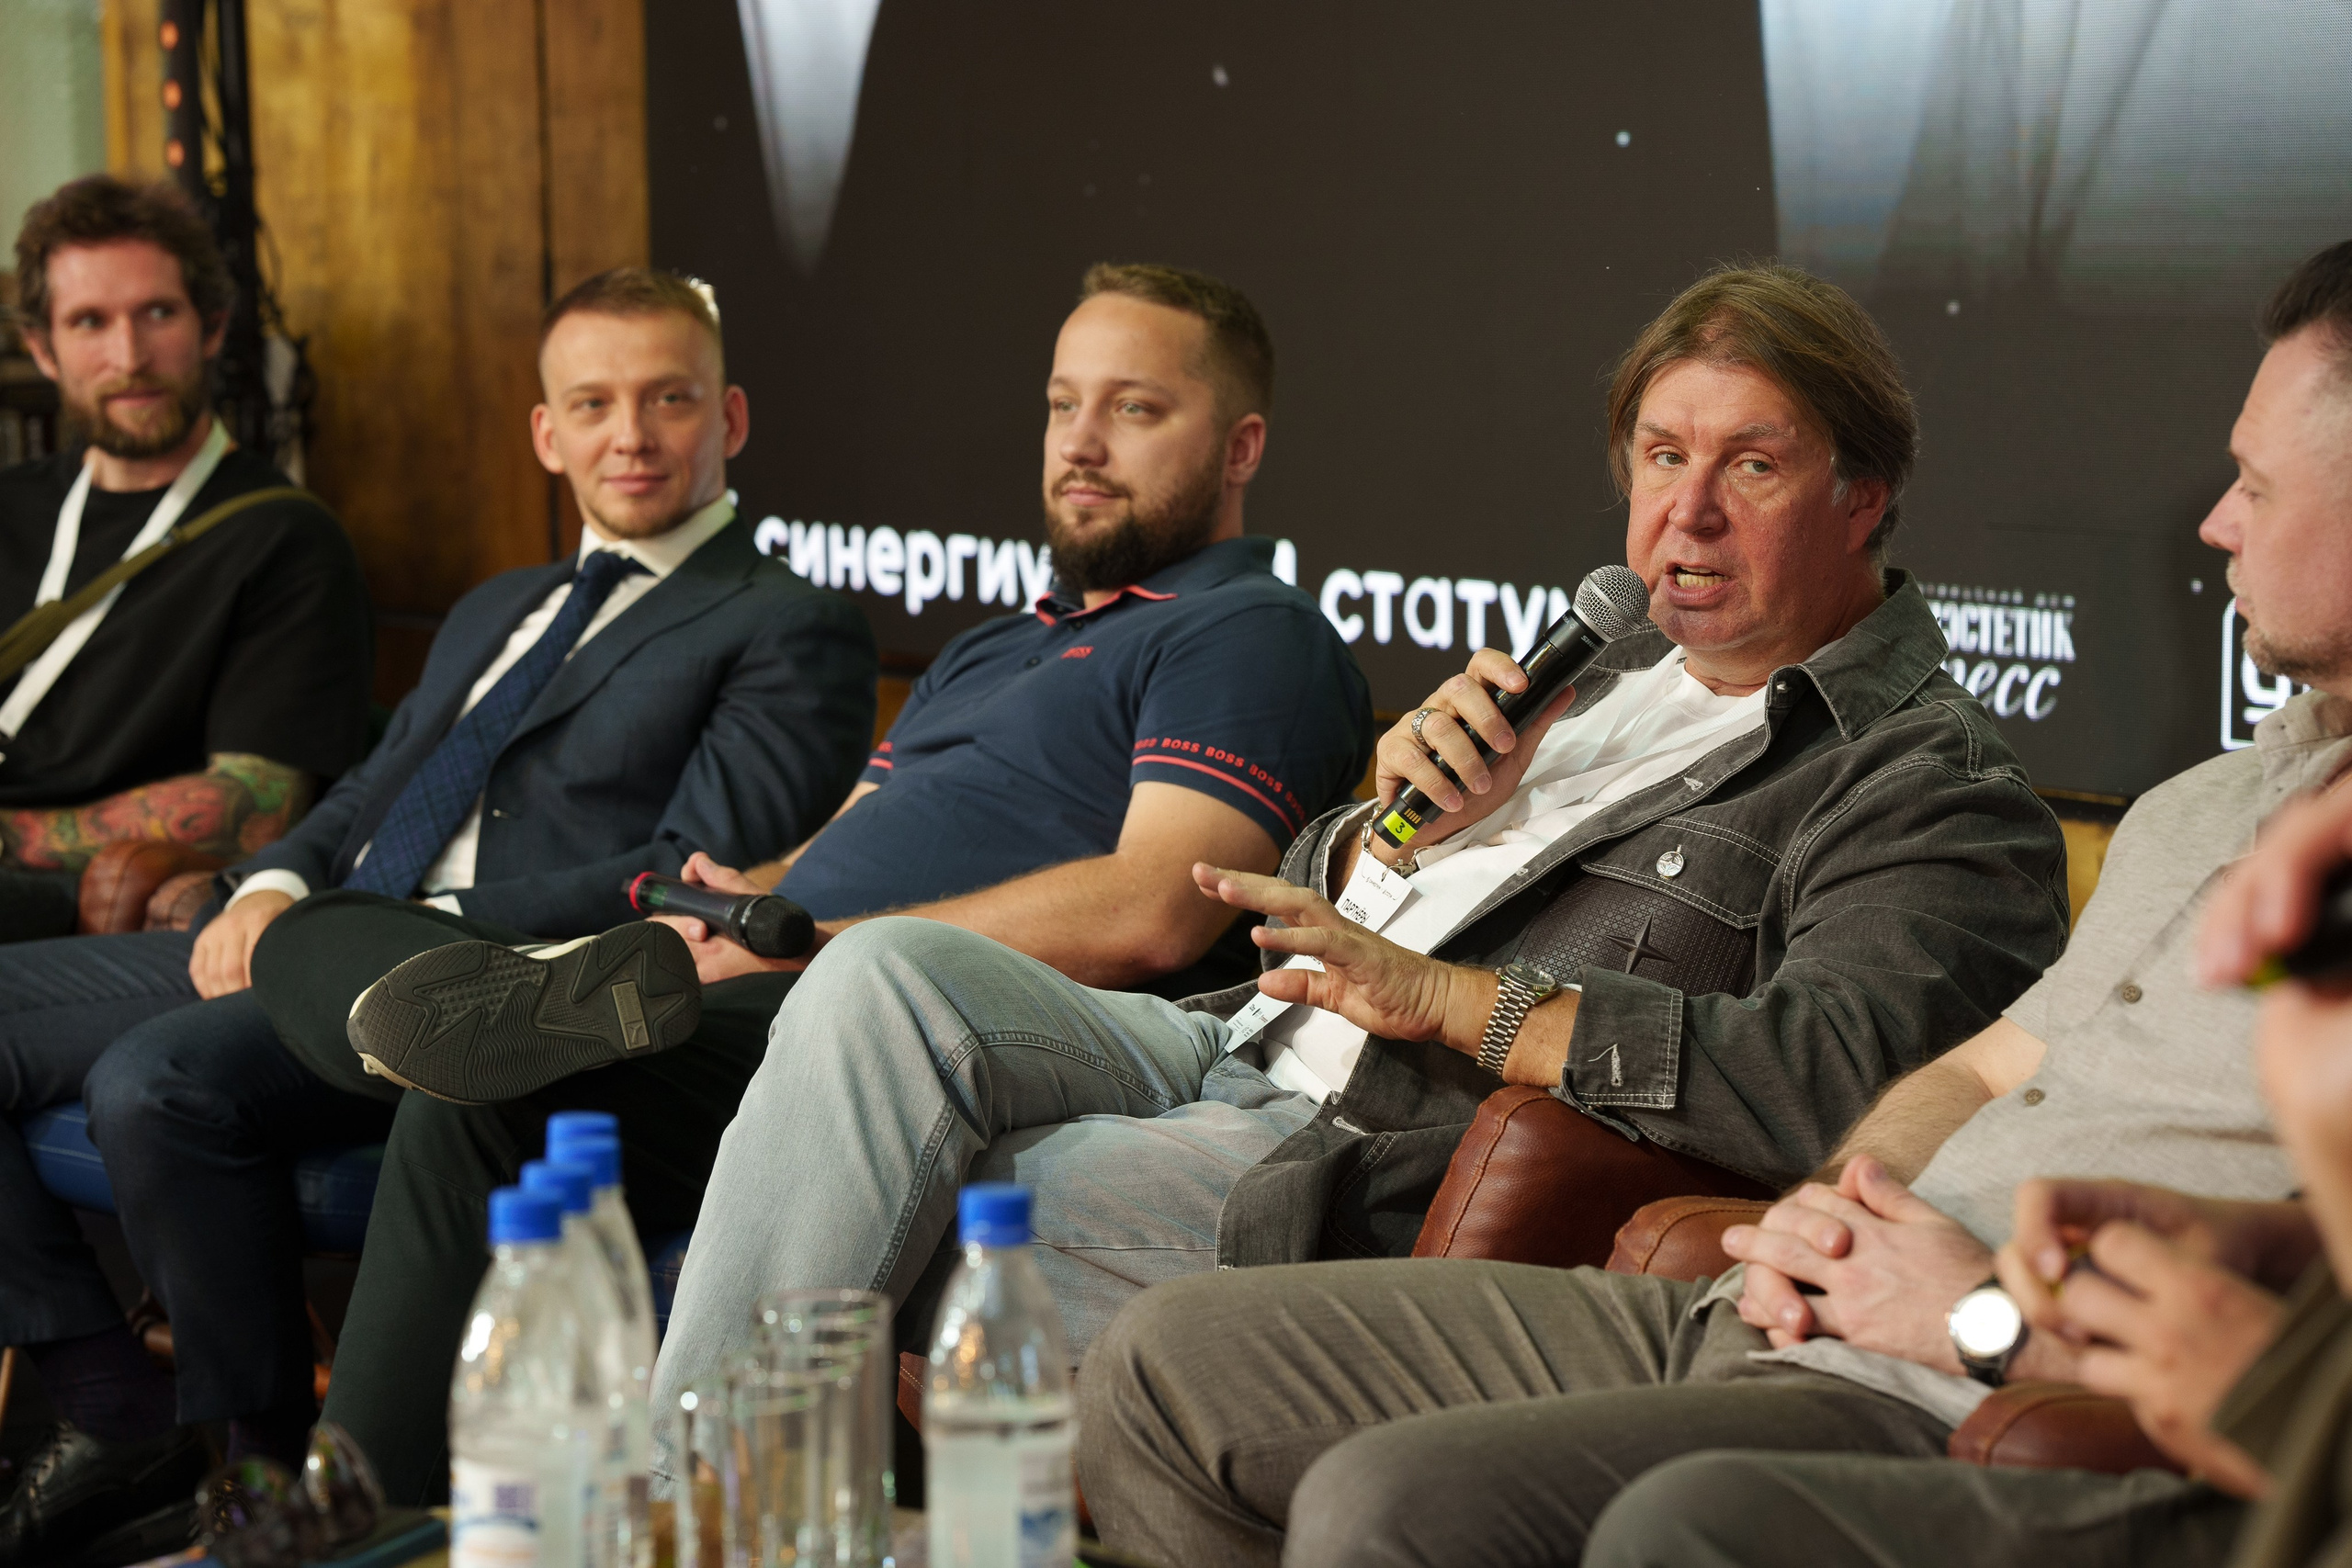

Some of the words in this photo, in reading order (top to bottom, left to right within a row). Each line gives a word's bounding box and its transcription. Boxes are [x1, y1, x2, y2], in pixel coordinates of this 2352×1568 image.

[1161, 737, 1201, 753] BOSS
[1204, 746, 1245, 768] BOSS
[1249, 763, 1283, 793] BOSS
